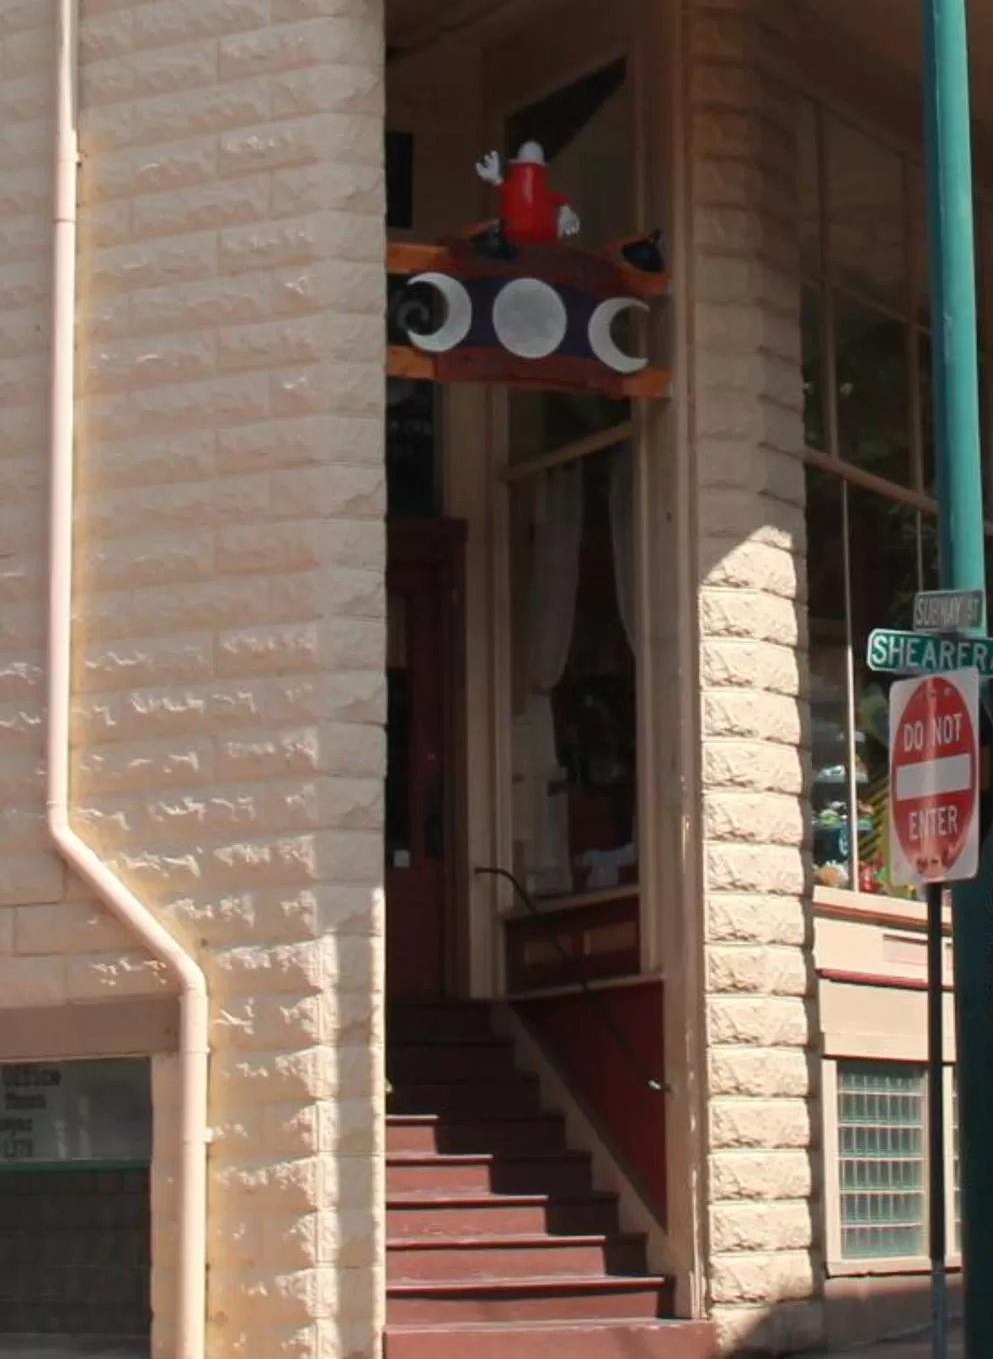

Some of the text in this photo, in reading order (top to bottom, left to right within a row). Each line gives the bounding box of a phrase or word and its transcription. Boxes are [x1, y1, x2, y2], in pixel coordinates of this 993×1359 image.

[915, 597, 962, 624] SUBWAY
[904, 713, 963, 752] DO NOT
[909, 804, 959, 841] ENTER
